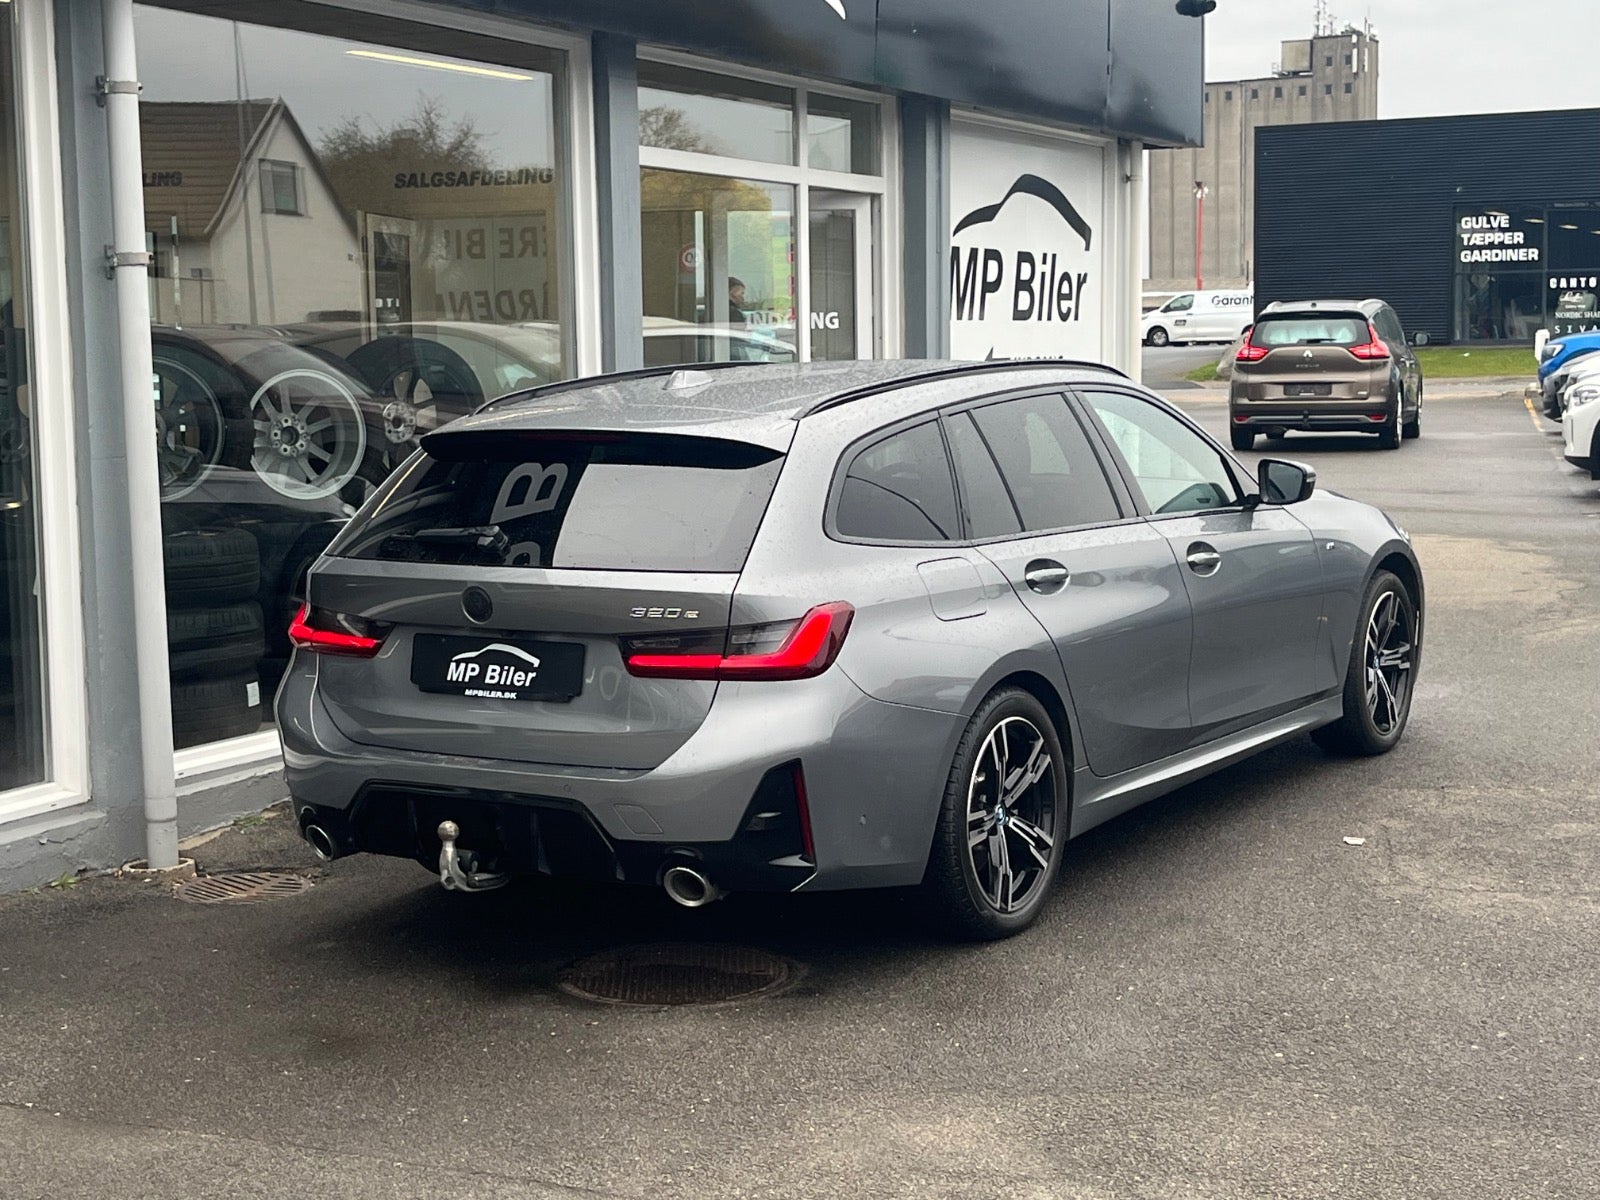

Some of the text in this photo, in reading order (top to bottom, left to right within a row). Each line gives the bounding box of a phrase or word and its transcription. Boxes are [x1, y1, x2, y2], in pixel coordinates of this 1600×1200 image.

[394, 168, 554, 189] SALGSAFDELING
[1461, 215, 1510, 229] GULVE
[1461, 231, 1524, 246] TÆPPER
[1460, 248, 1539, 262] GARDINER
[950, 246, 1088, 322] MP Biler
[446, 662, 536, 687] MP Biler
